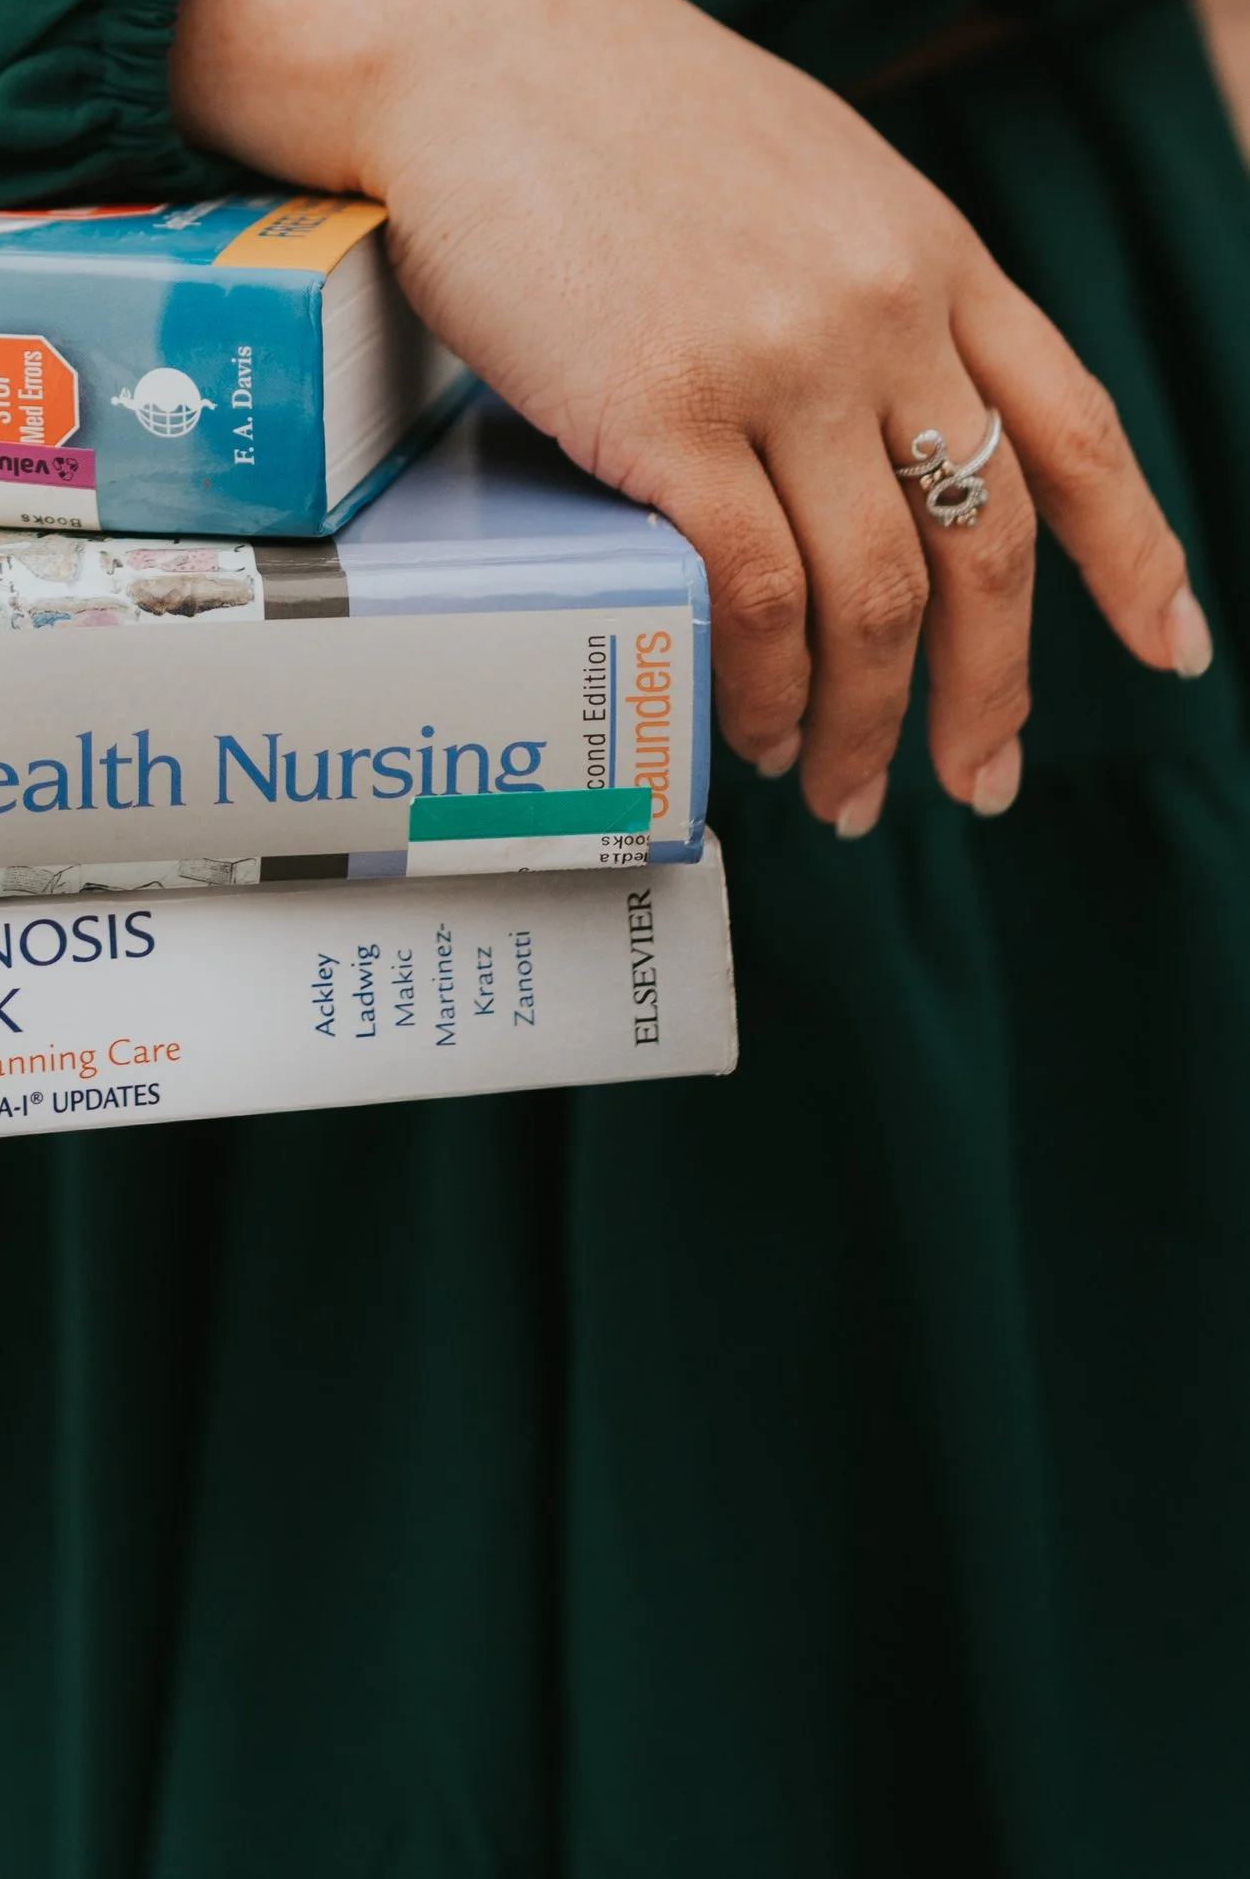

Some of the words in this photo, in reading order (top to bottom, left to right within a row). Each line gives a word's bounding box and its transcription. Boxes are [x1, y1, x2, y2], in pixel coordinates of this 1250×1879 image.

[17, 349, 44, 401] Errors
[231, 345, 253, 409] Davis
[18, 406, 46, 445] Med
[232, 416, 254, 441] A.
[234, 448, 255, 465] F.
[21, 513, 82, 528] Books
[582, 634, 608, 723] Edition
[213, 724, 549, 805] Nursing
[582, 732, 607, 790] cond
[311, 952, 340, 1038] Ackley
[351, 943, 380, 1038] Ladwig
[390, 948, 416, 1027] Makic
[431, 921, 457, 1047] Martinez-
[473, 946, 495, 1017] Kratz
[508, 929, 535, 1027] Zanotti
[626, 887, 660, 1048] ELSEVIER
[107, 1038, 182, 1066] Care
[52, 1082, 161, 1113] UPDATES
